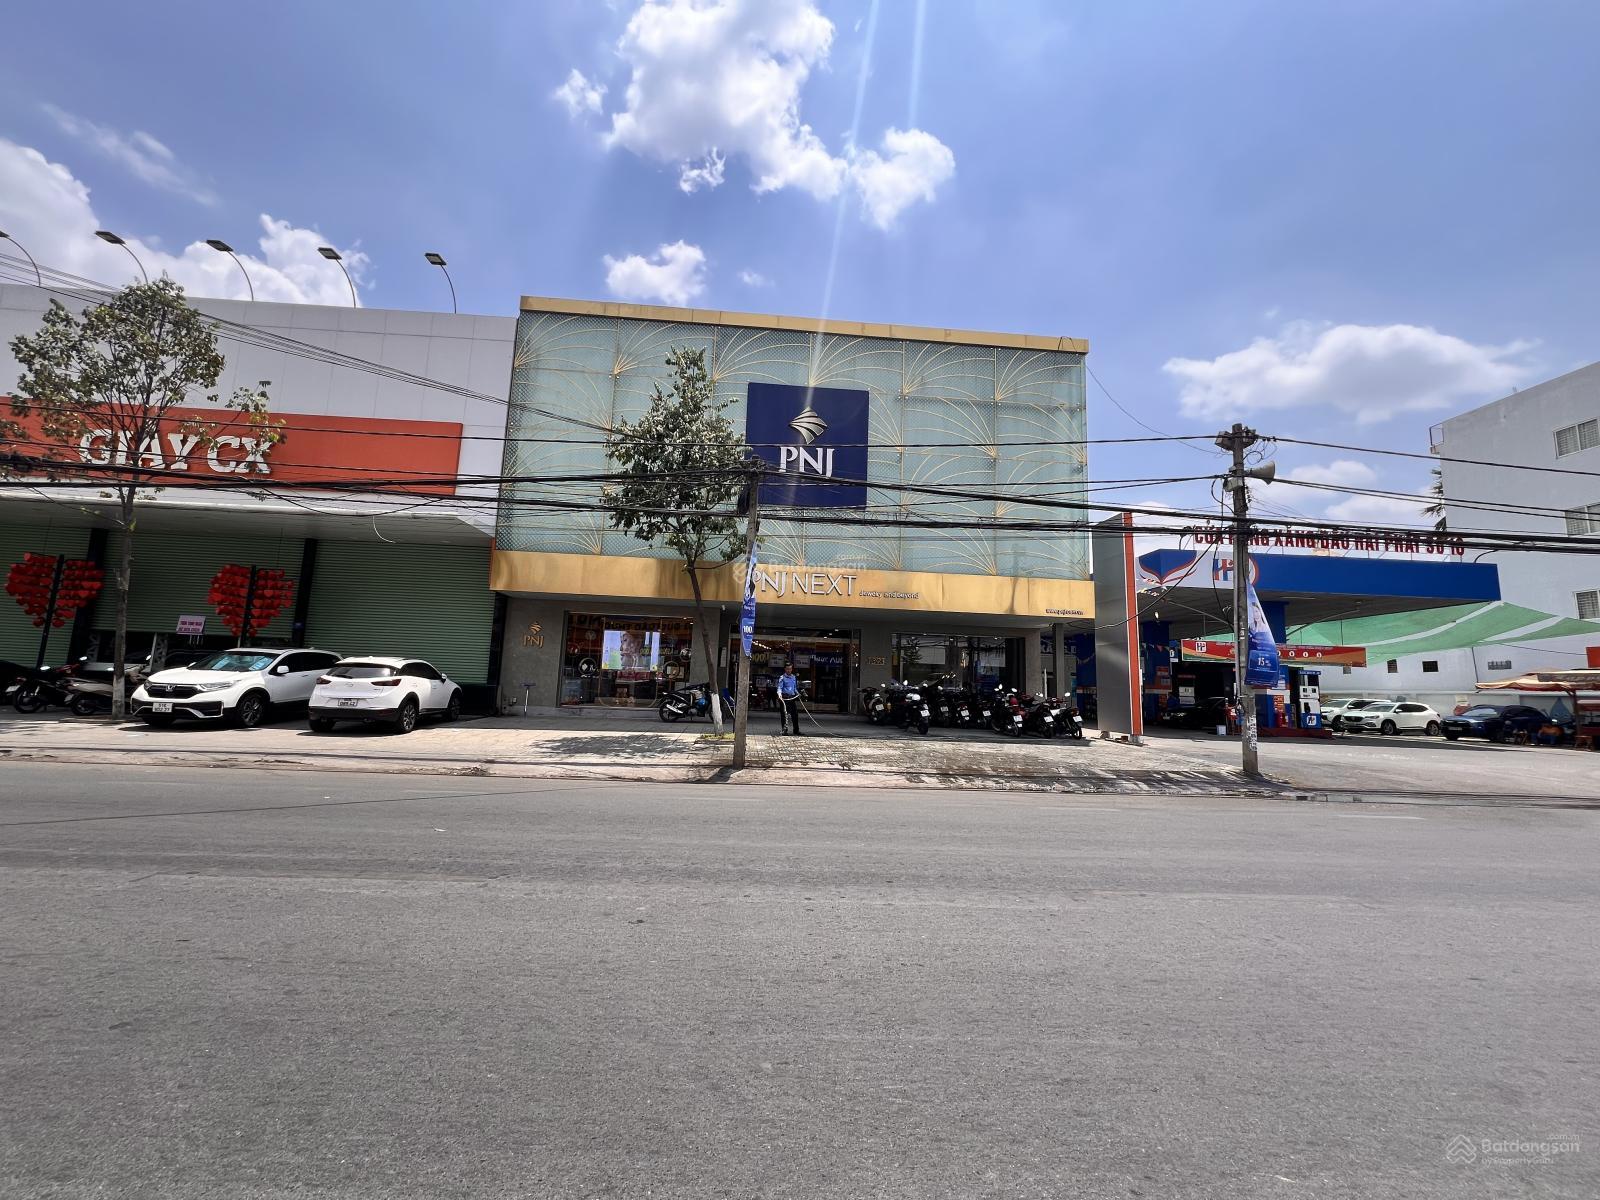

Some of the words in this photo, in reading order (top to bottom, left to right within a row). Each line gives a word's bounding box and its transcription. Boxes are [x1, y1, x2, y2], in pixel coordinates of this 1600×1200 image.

[207, 435, 272, 474] CX
[778, 446, 835, 478] PNJ
[791, 572, 857, 597] NEXT
[522, 634, 545, 649] PNJ
